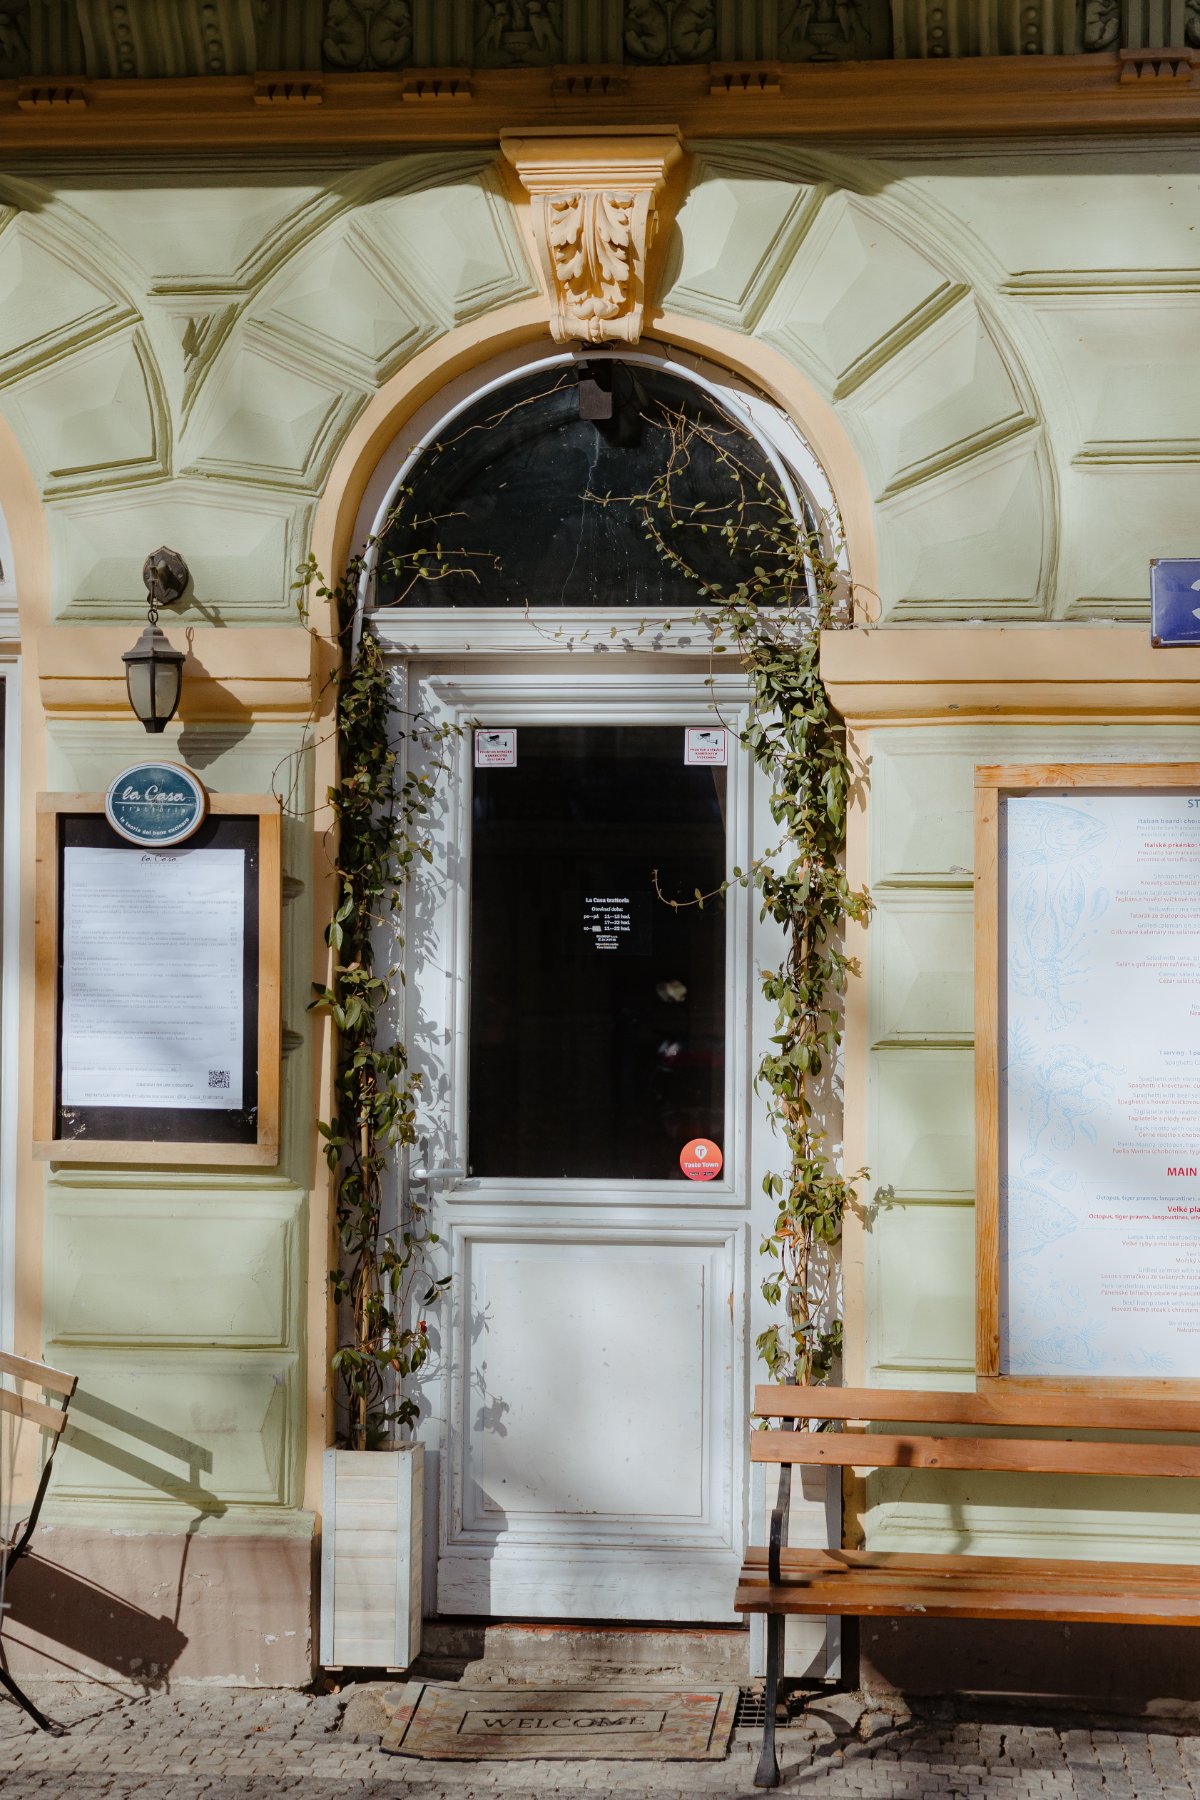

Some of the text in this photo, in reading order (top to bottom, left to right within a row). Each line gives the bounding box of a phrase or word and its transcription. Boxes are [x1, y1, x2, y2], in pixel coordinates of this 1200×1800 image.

[122, 785, 185, 802] la Casa
[1187, 799, 1200, 808] ST
[1166, 1167, 1197, 1177] MAIN
[482, 1716, 645, 1729] WELCOME
